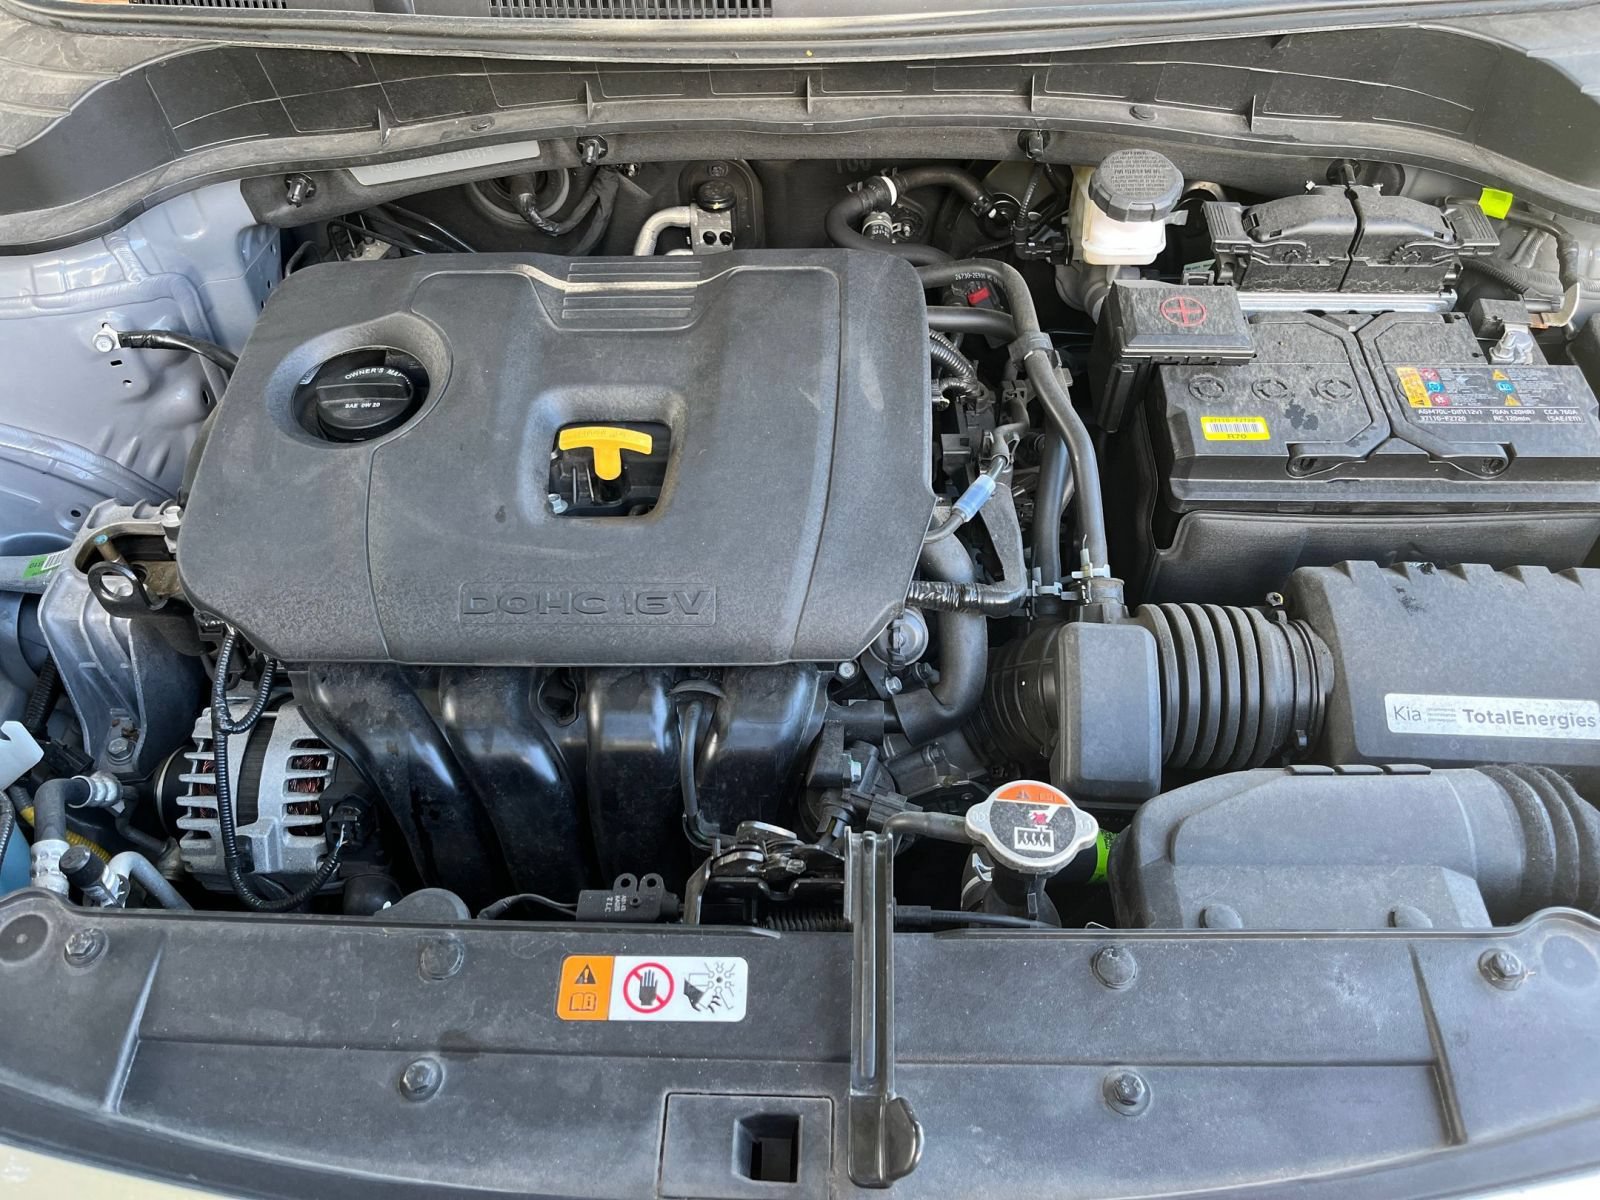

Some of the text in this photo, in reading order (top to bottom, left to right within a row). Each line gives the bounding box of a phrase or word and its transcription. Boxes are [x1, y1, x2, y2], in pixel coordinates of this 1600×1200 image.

[345, 367, 385, 380] OWNER'S
[463, 591, 712, 615] DOHC 16V
[1393, 705, 1422, 722] Kia
[1462, 708, 1596, 729] TotalEnergies
